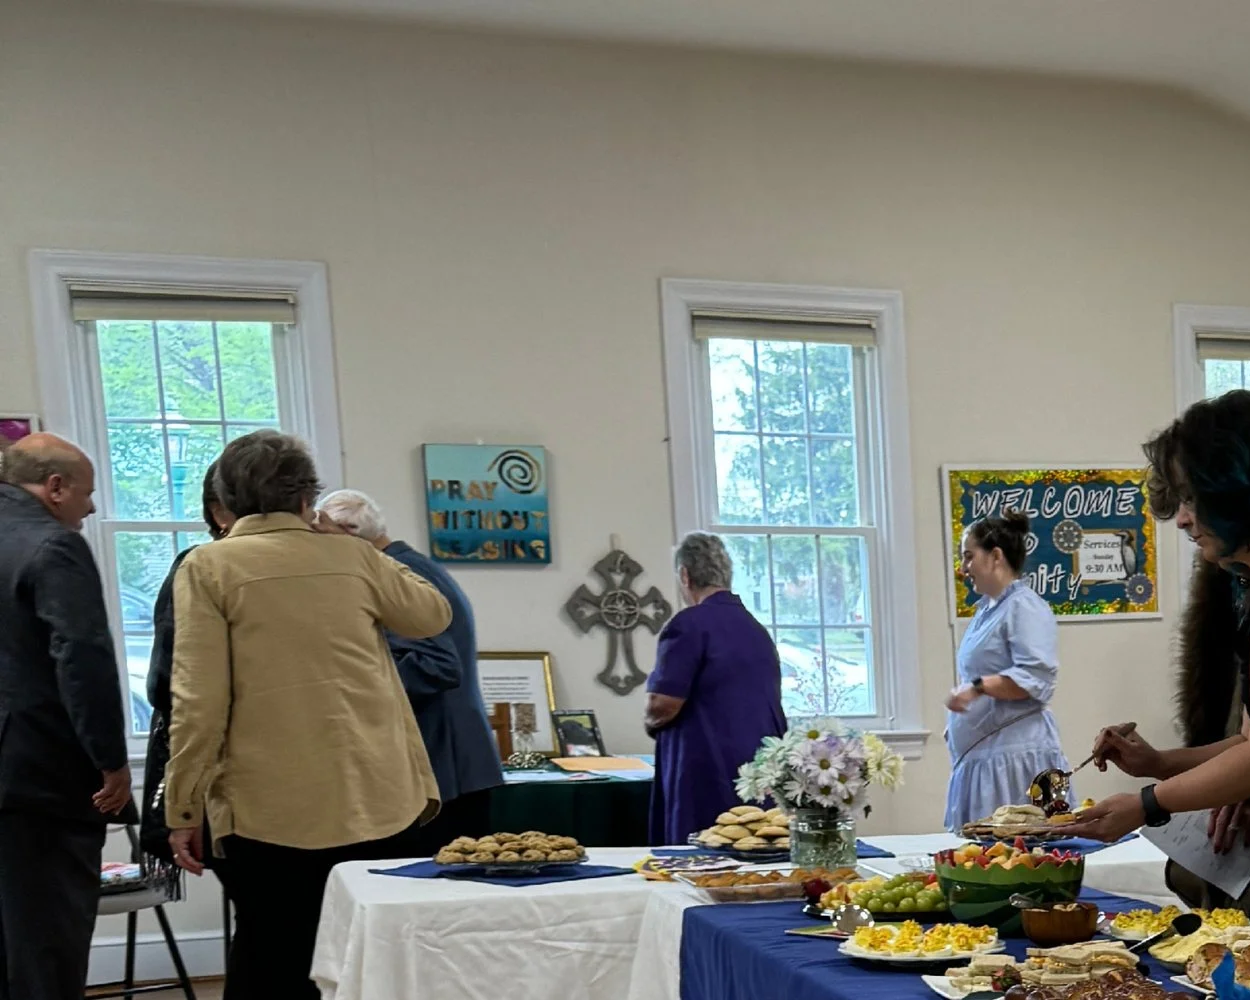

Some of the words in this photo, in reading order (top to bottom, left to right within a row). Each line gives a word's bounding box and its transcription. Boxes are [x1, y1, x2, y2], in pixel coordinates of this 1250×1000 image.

[430, 480, 497, 501] PRAY
[972, 485, 1139, 519] WELCOME
[431, 510, 546, 531] WITHOUT
[1083, 538, 1121, 549] Services
[1085, 564, 1104, 573] 9:30
[1106, 564, 1123, 573] AM
